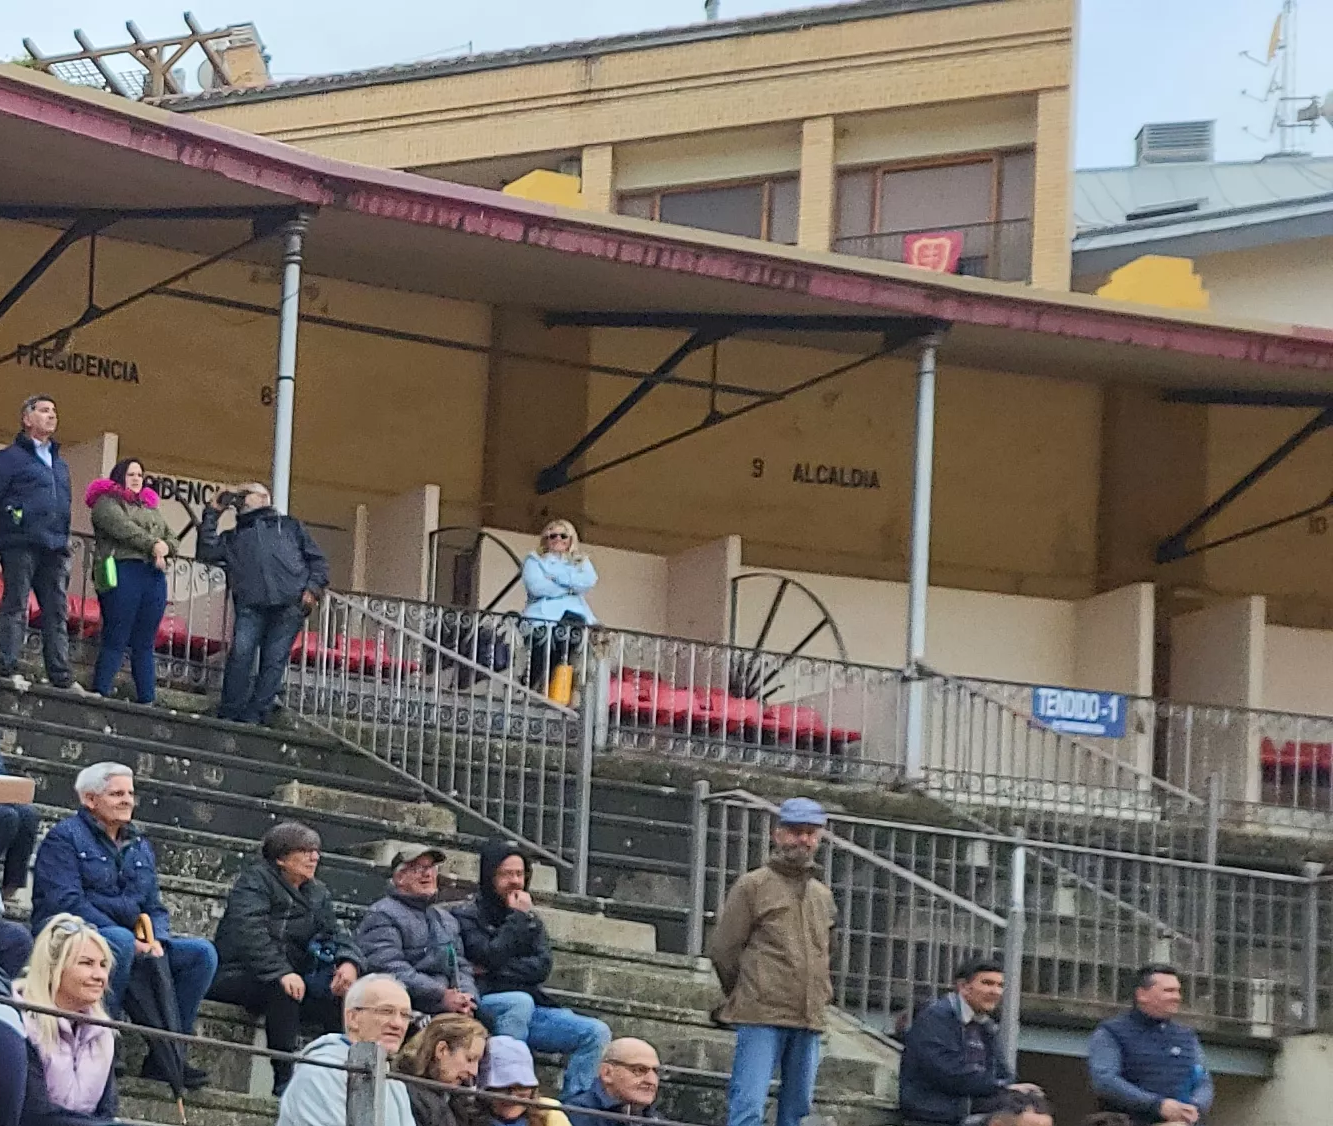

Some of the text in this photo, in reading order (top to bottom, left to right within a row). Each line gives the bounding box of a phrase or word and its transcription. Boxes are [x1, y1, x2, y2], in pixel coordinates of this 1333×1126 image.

[16, 343, 140, 384] PRESIDENCIA
[261, 385, 273, 406] 8
[751, 457, 881, 489] 9 ALCALDIA
[1307, 515, 1329, 536] 10
